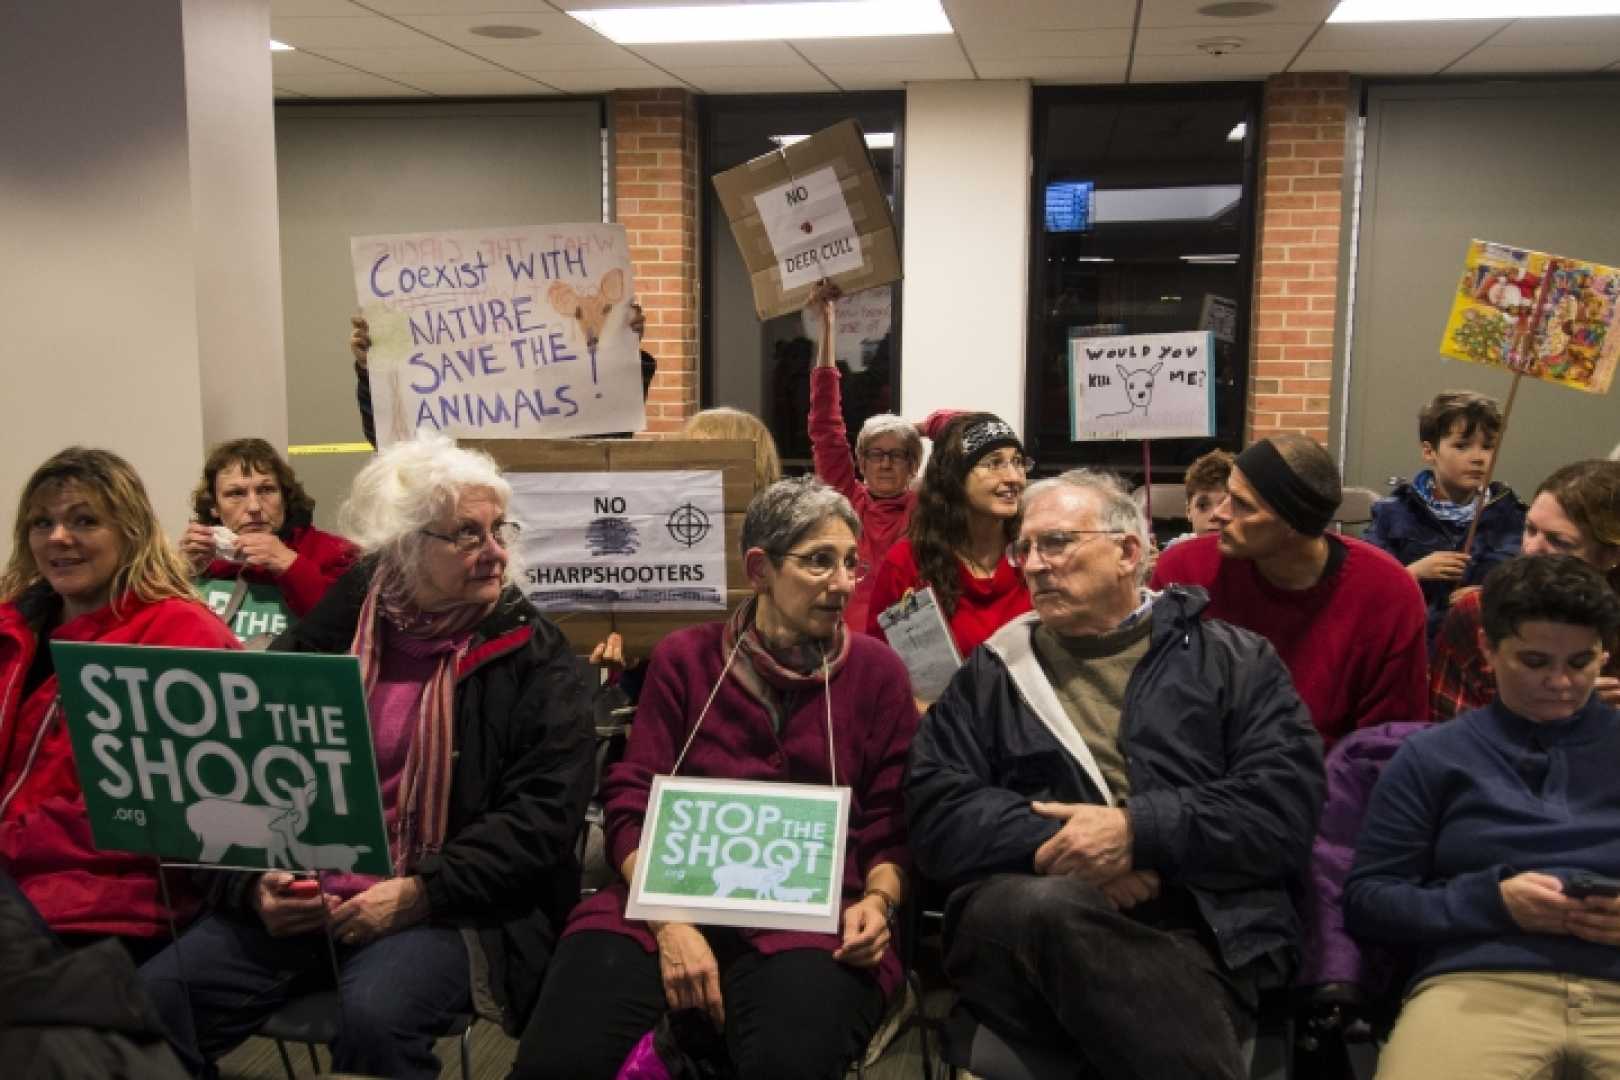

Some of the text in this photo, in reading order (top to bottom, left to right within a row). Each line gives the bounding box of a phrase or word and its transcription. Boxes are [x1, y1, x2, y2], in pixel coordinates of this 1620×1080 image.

[785, 186, 808, 207] NO
[370, 252, 489, 297] Coexist
[506, 248, 588, 280] WITH
[785, 238, 853, 273] DEER CULL
[409, 296, 546, 345] NATURE
[409, 333, 577, 394] SAVE THE
[1158, 345, 1198, 360] YOU
[593, 496, 626, 514] NO
[527, 563, 704, 584] SHARPSHOOTERS
[235, 610, 287, 636] THE
[80, 663, 347, 746] STOP THE
[91, 731, 351, 816] SHOOT
[668, 799, 827, 840] STOP THE
[661, 832, 825, 874] SHOOT
